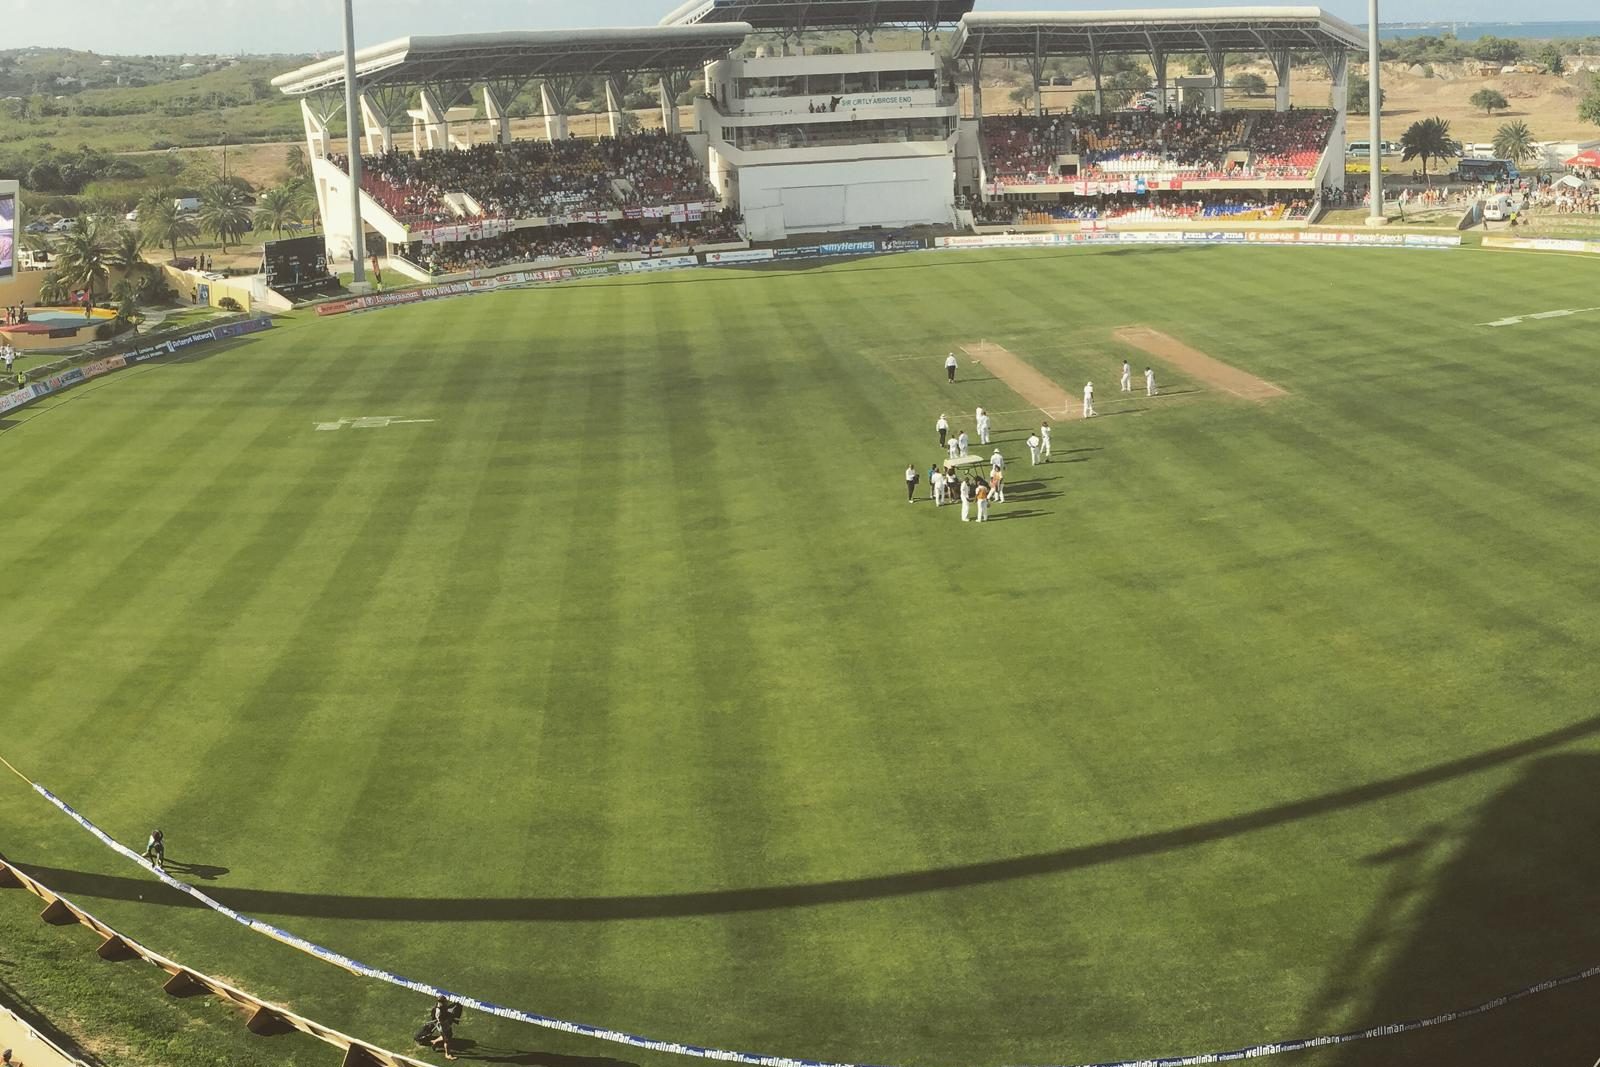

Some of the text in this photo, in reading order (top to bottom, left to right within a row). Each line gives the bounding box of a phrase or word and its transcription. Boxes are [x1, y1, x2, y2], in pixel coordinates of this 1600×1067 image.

[899, 96, 911, 104] END
[575, 267, 608, 275] Waitrose
[407, 980, 437, 997] wellman
[1529, 980, 1558, 994] wellman
[450, 994, 481, 1010] wellman
[1480, 996, 1507, 1013] wellman
[494, 1007, 527, 1022] wellman
[541, 1018, 578, 1034] wellman
[594, 1028, 630, 1045] wellman
[704, 1049, 744, 1063] wellman
[1246, 1043, 1281, 1059] wellman
[760, 1056, 802, 1067] wellman
[1182, 1053, 1217, 1066] wellman
